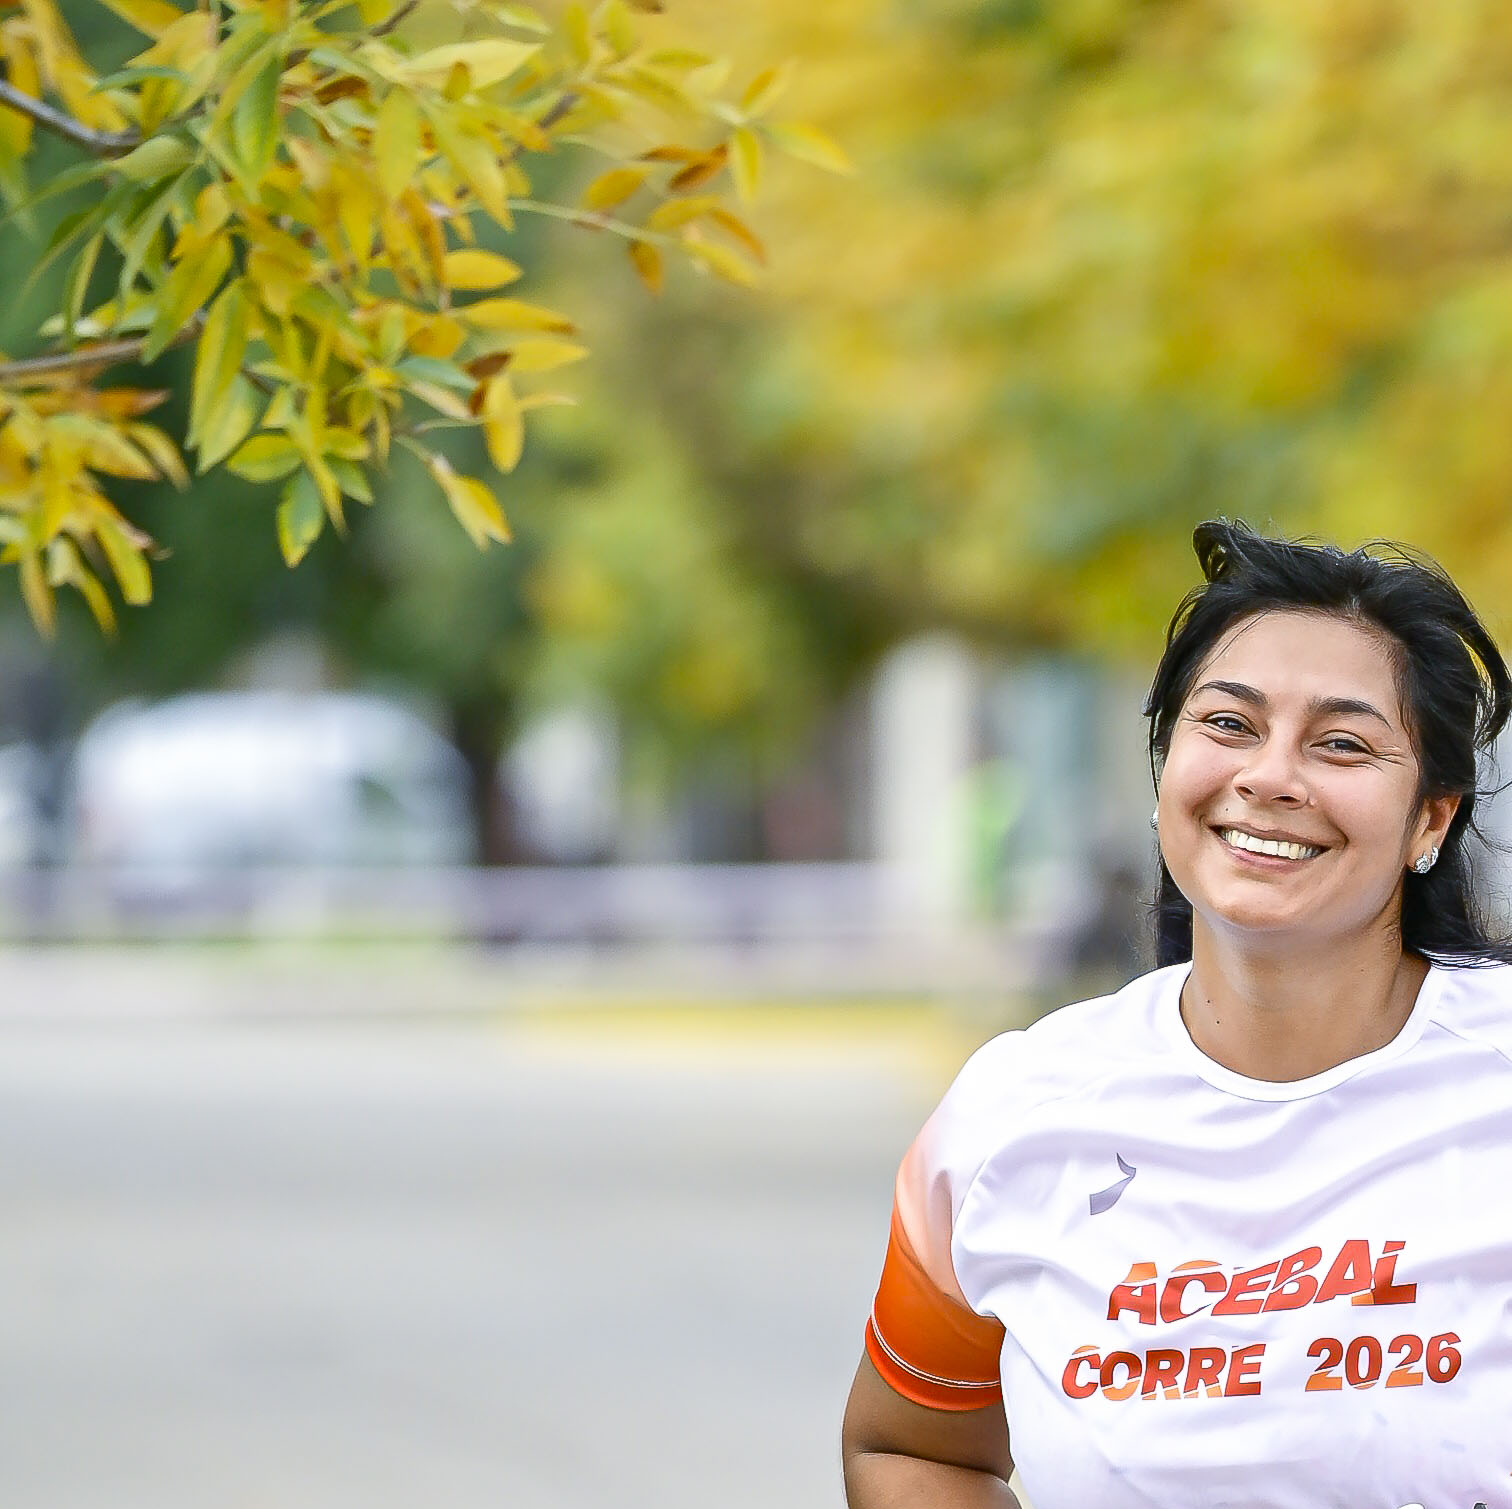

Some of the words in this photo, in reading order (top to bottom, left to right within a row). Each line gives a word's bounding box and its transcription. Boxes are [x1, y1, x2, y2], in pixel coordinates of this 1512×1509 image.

[1106, 1239, 1417, 1325] ACEBAL
[1061, 1343, 1266, 1401] CORRE
[1305, 1332, 1462, 1392] 2026
